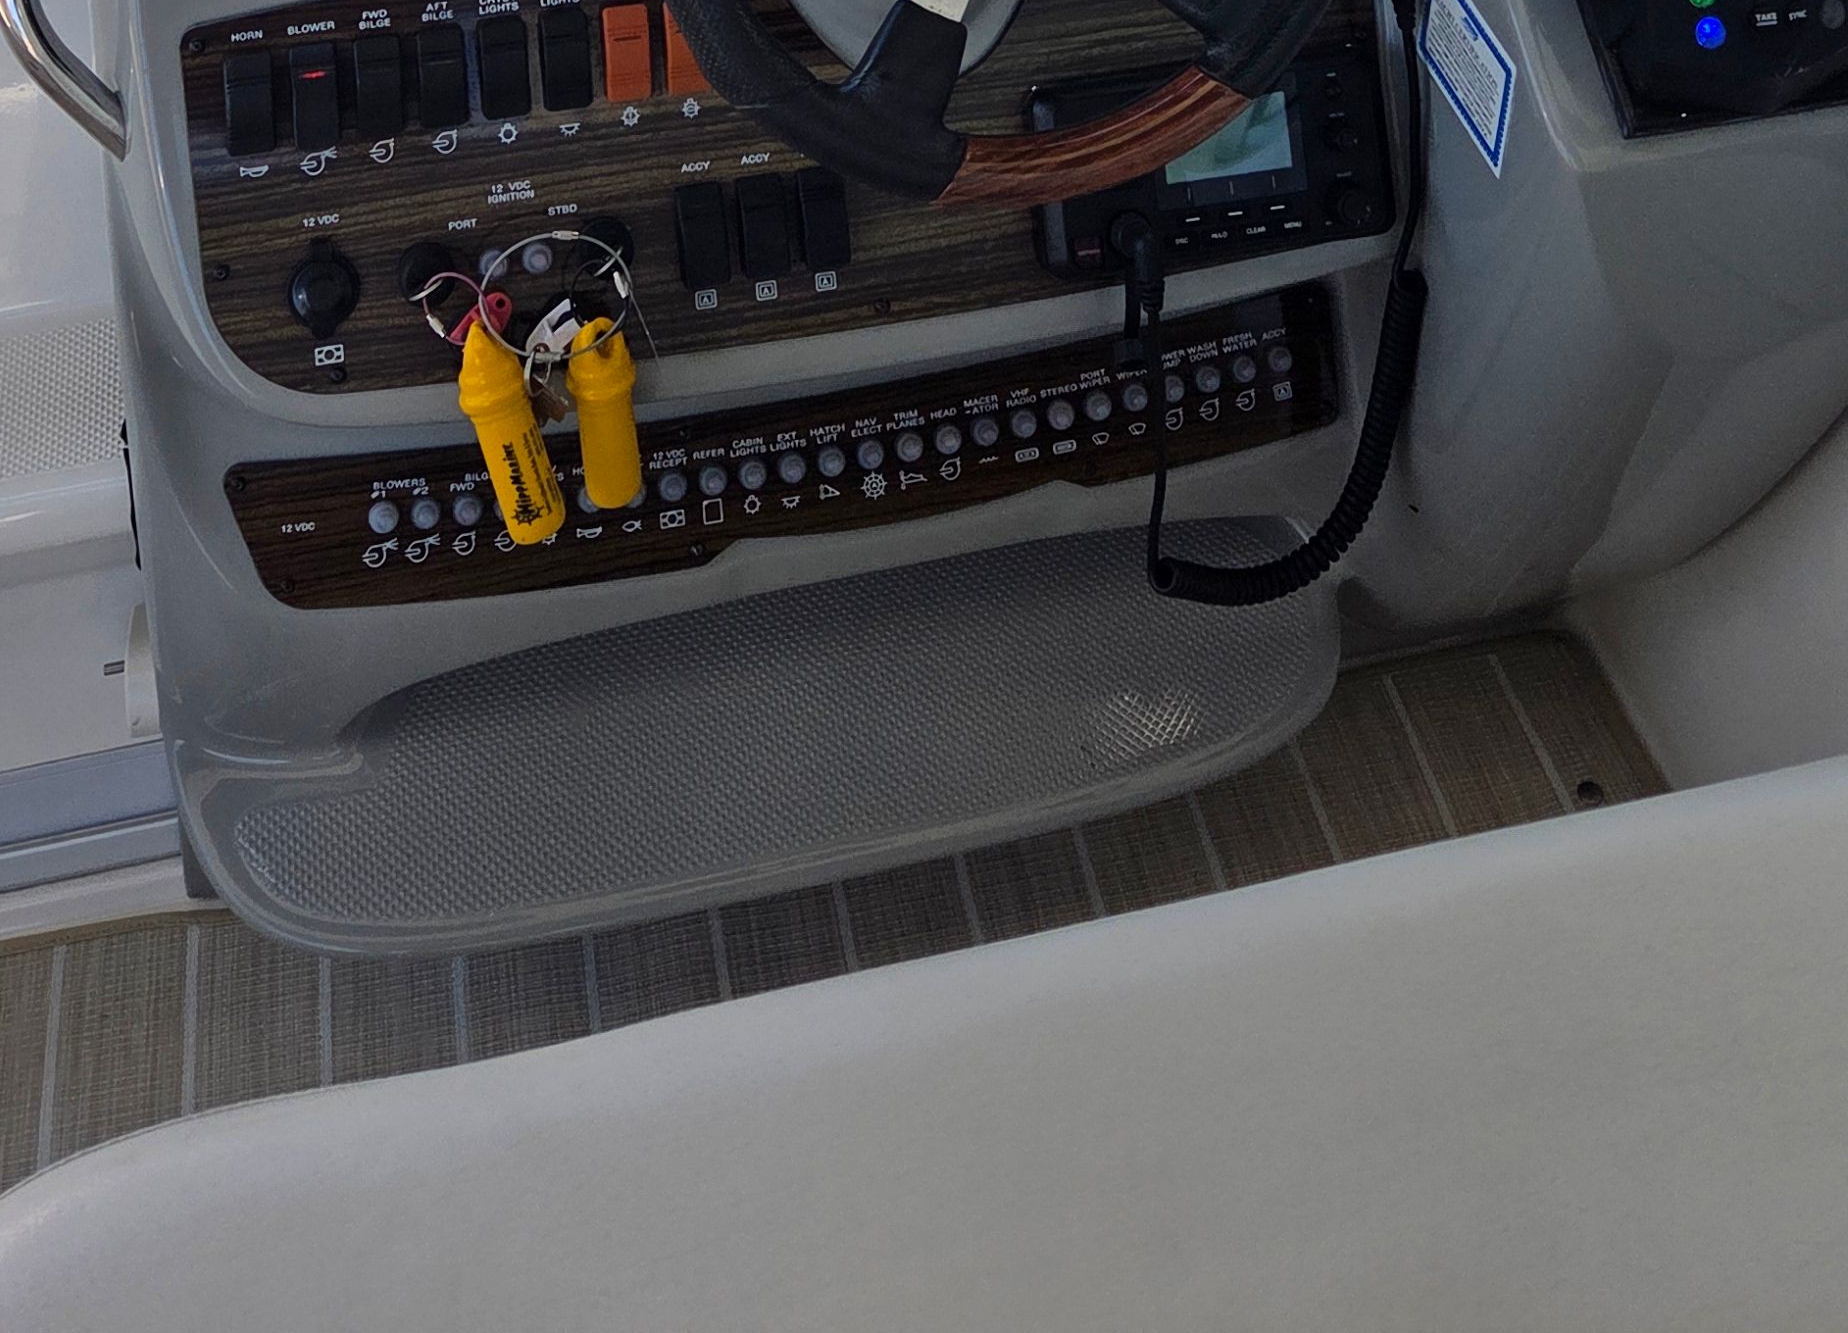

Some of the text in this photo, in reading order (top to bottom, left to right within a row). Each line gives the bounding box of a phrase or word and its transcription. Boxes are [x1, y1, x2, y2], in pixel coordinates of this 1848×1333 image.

[426, 1, 448, 12] AFT
[478, 1, 519, 15] LIGHTS
[362, 9, 388, 20] FWD
[421, 10, 453, 22] BILGE
[287, 21, 335, 36] BLOWER
[358, 18, 391, 30] BILGE
[231, 30, 263, 43] HORN
[741, 152, 770, 165] ACCY
[681, 161, 710, 173] ACCY
[492, 180, 531, 194] 12 VDC
[487, 189, 535, 204] IGNITION
[548, 203, 577, 216] STBD
[302, 213, 339, 228] 12 VDC
[448, 218, 478, 231] PORT
[1222, 331, 1253, 345] FRESH
[1186, 341, 1217, 354] WASH
[1222, 339, 1258, 354] WATER
[1189, 349, 1219, 363] DOWN
[1080, 368, 1106, 381] PORT
[1079, 376, 1111, 390] WIPER
[1010, 388, 1029, 399] VHF
[1040, 383, 1078, 398] STEREO
[963, 394, 999, 408] MACER
[1006, 395, 1037, 408] RADIO
[893, 409, 918, 421] TRIM
[930, 408, 957, 420] HEAD
[855, 417, 877, 428] NAV
[886, 418, 925, 431] PLANES
[777, 431, 797, 442] EXT
[810, 423, 845, 437] HATCH
[851, 425, 883, 438] ELECT
[732, 436, 763, 449] CABIN
[769, 438, 807, 452] LIGHTS
[816, 434, 838, 445] LIFT
[653, 449, 685, 461] 12 VDC
[693, 448, 725, 461] REFER
[729, 444, 767, 458] LIGHTS
[649, 457, 687, 470] RECEPT
[465, 471, 490, 482] BILG
[372, 477, 426, 491] BLOWERS
[450, 482, 475, 492] FWD
[281, 521, 316, 533] 12 VDC
